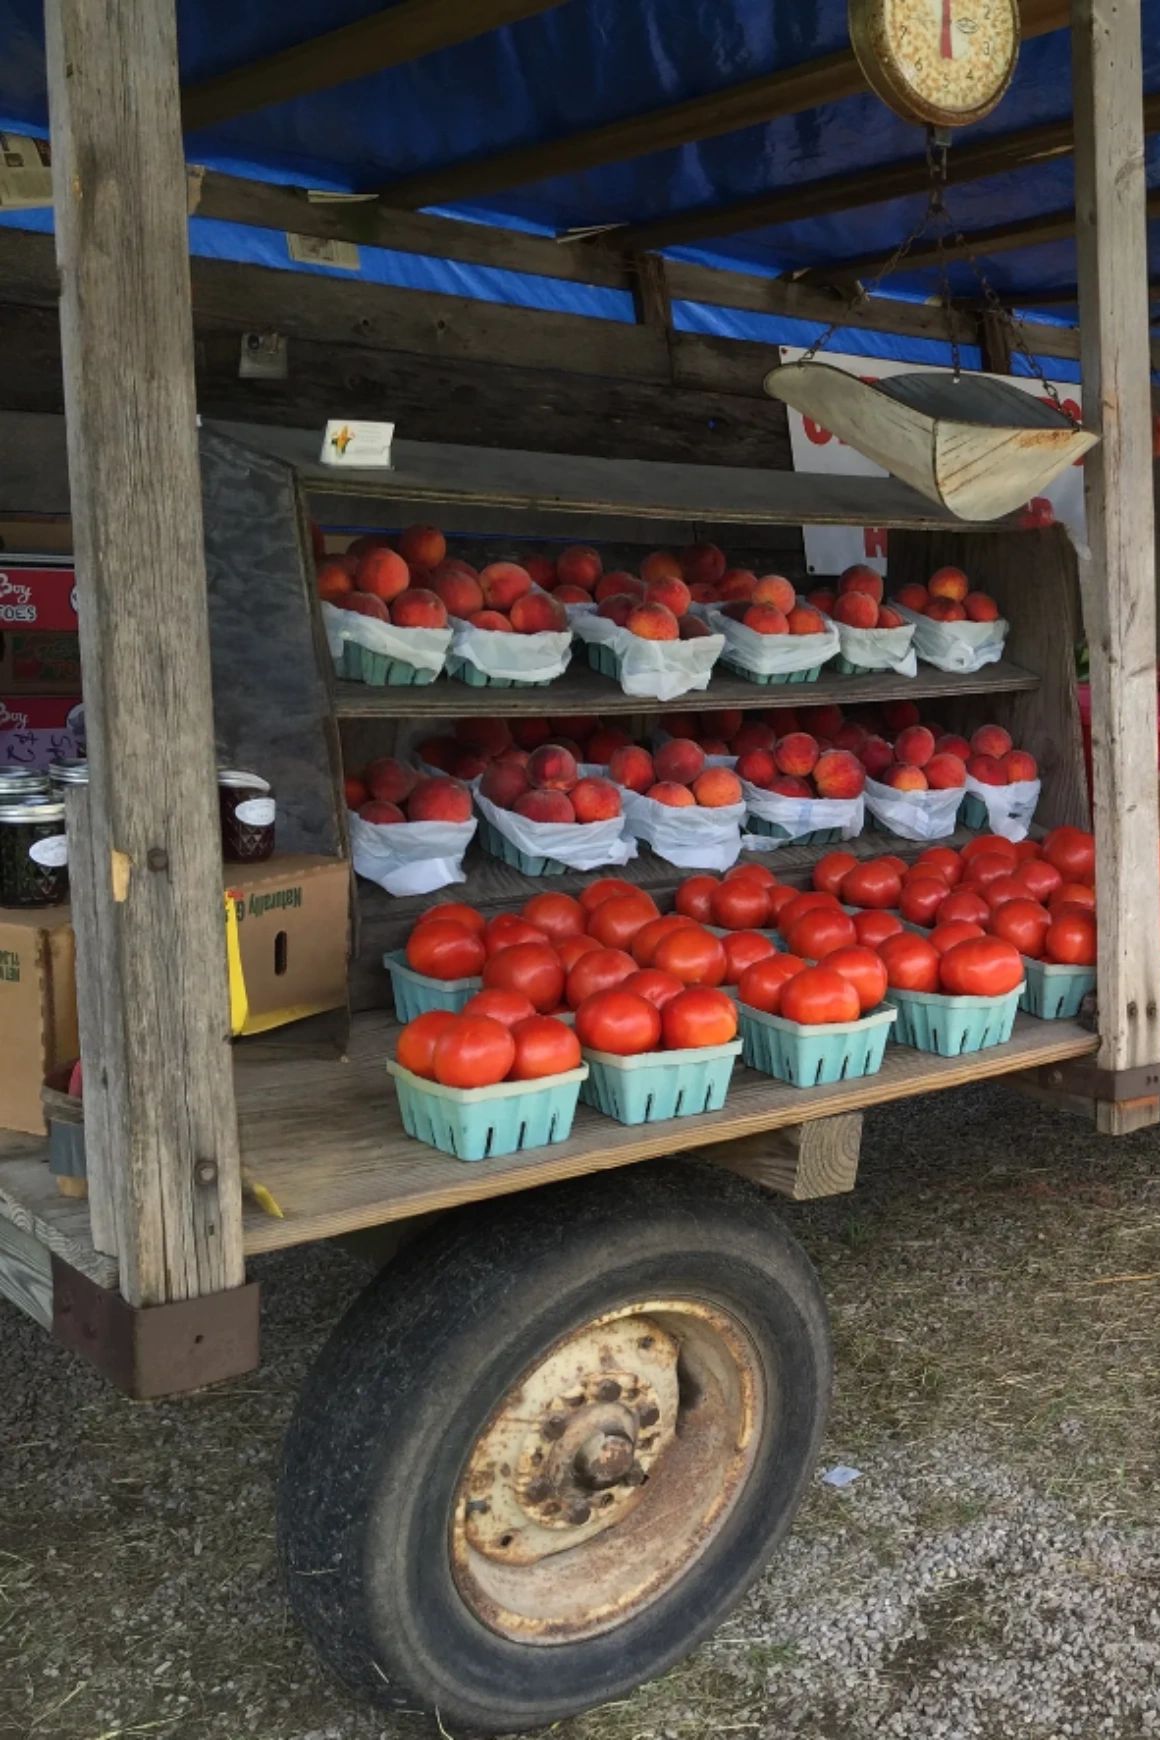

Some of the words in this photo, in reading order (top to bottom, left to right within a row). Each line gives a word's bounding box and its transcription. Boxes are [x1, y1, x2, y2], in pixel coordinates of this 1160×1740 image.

[983, 4, 991, 20] 2
[900, 25, 907, 40] 7
[983, 41, 990, 56] 3
[914, 57, 923, 72] 6
[965, 69, 974, 80] 4
[249, 887, 302, 917] Naturally
